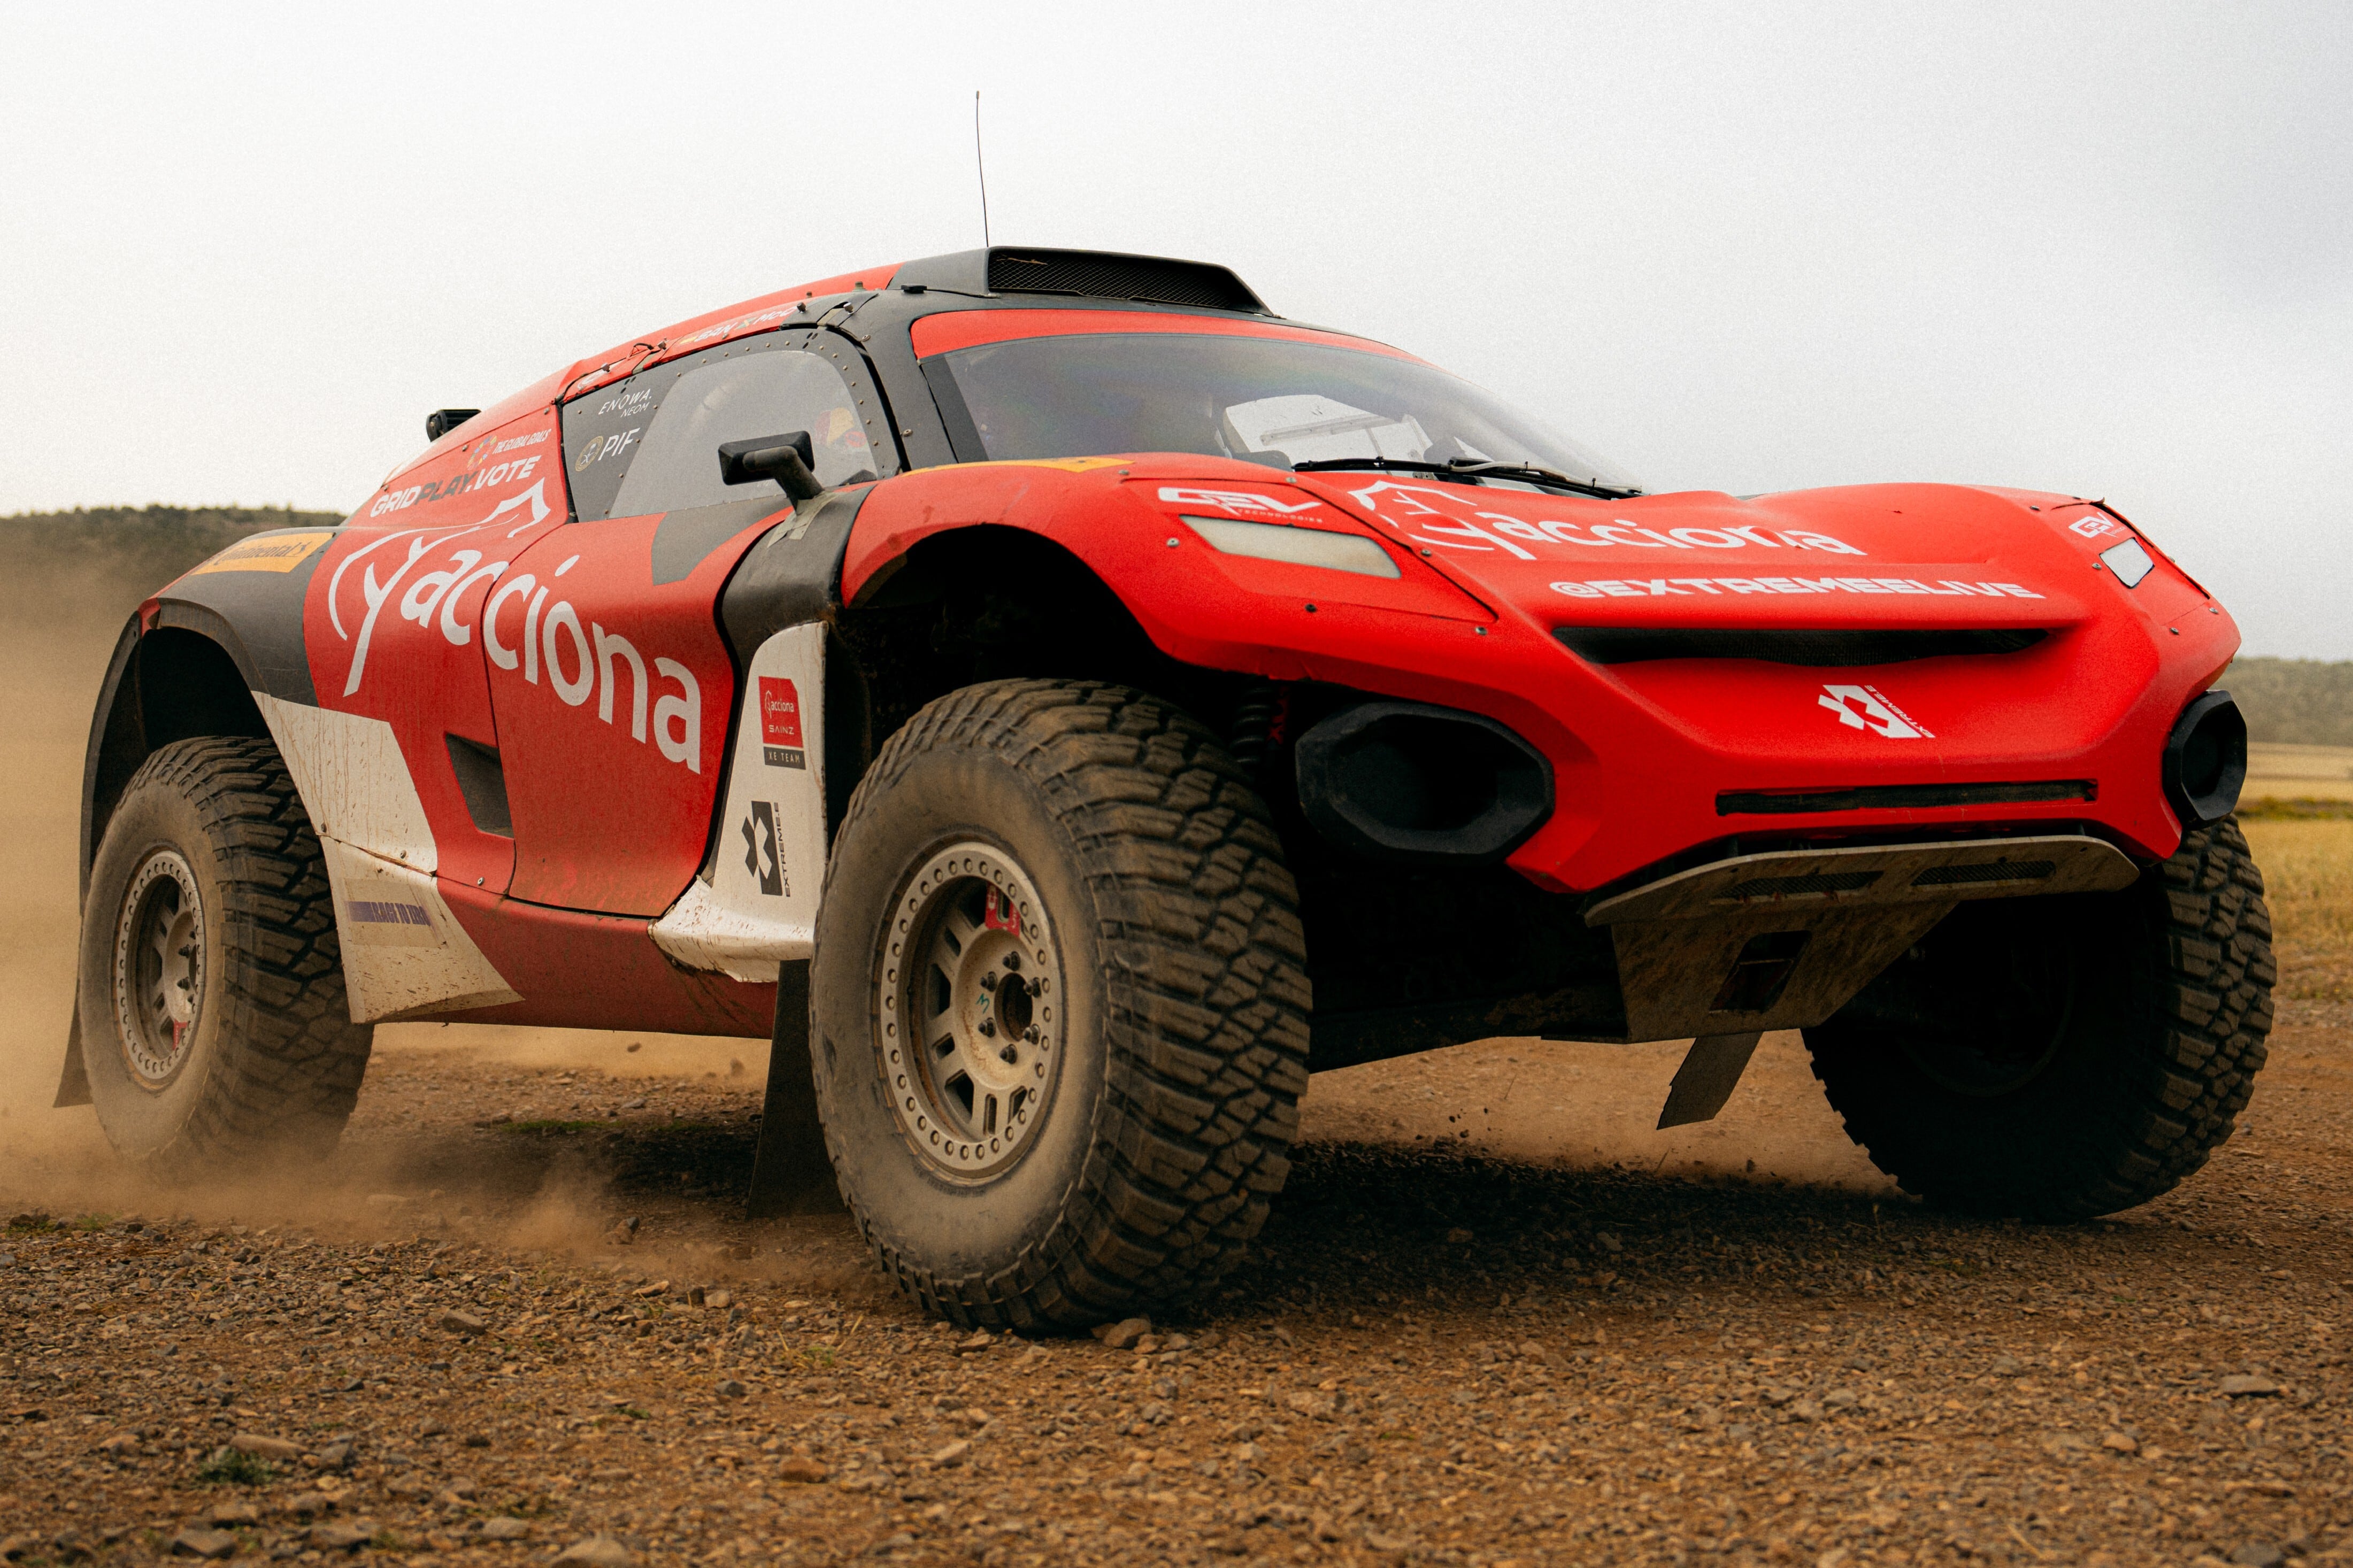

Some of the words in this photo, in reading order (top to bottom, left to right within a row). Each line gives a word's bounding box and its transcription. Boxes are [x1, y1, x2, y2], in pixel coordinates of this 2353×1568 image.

[620, 401, 650, 418] NEOM
[493, 440, 509, 454] THE
[503, 434, 530, 451] GLOBAL
[526, 428, 552, 445] GOALS
[597, 428, 641, 461] PIF
[1238, 508, 1322, 523] TECHNOLOGIES
[1474, 511, 1867, 556] acciona
[1549, 577, 2047, 598] @EXTREMEELIVE
[401, 550, 701, 775] acciona
[771, 698, 794, 712] acciona
[769, 724, 794, 735] SAINZ
[769, 751, 777, 760] XE
[781, 753, 801, 763] TEAM
